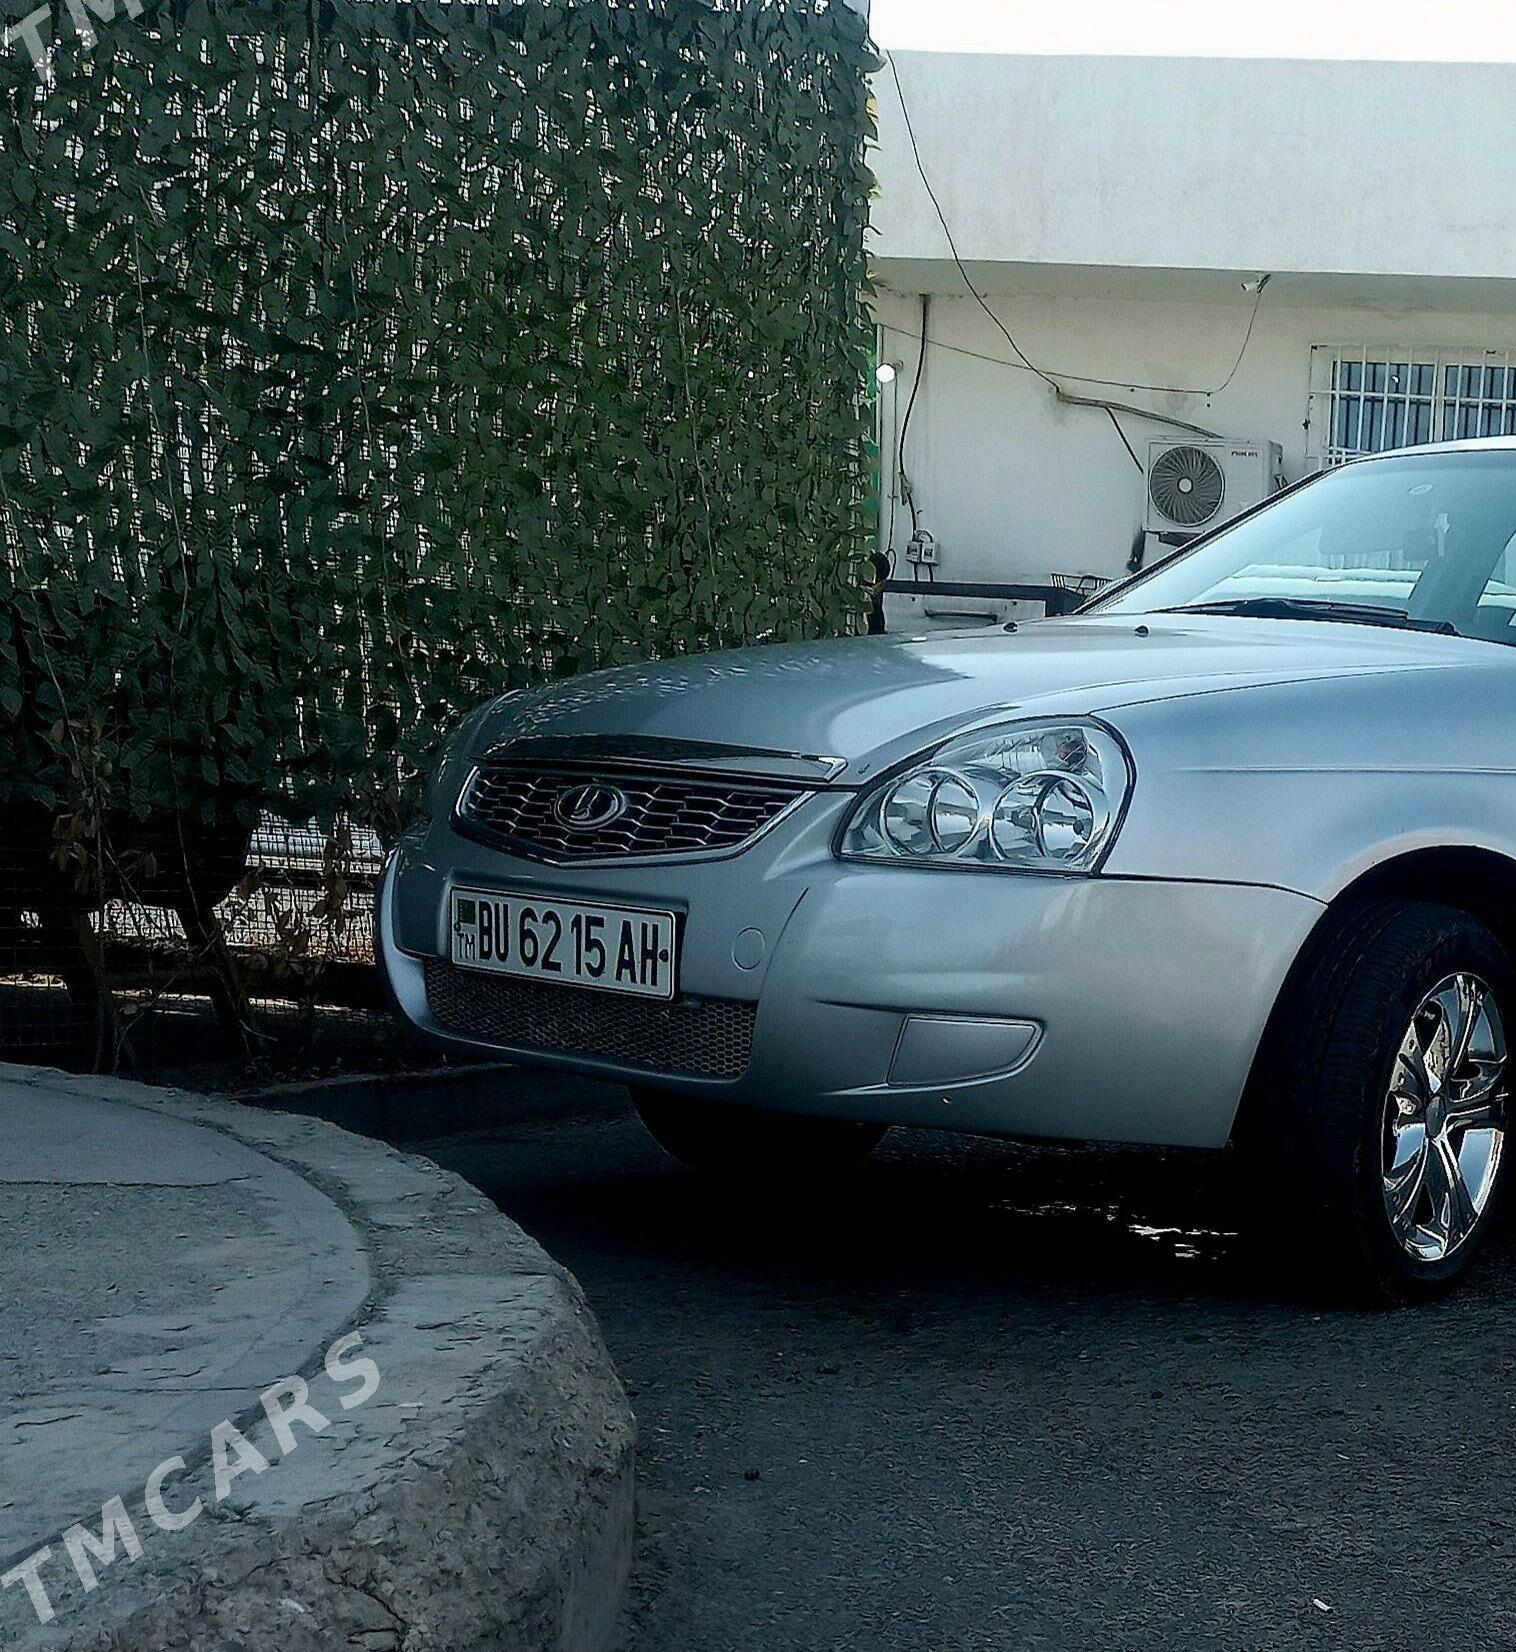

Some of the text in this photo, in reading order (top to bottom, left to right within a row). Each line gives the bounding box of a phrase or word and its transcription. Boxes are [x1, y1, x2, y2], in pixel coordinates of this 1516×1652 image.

[457, 932, 476, 961] TM
[478, 901, 659, 987] BU 62 15 AH
